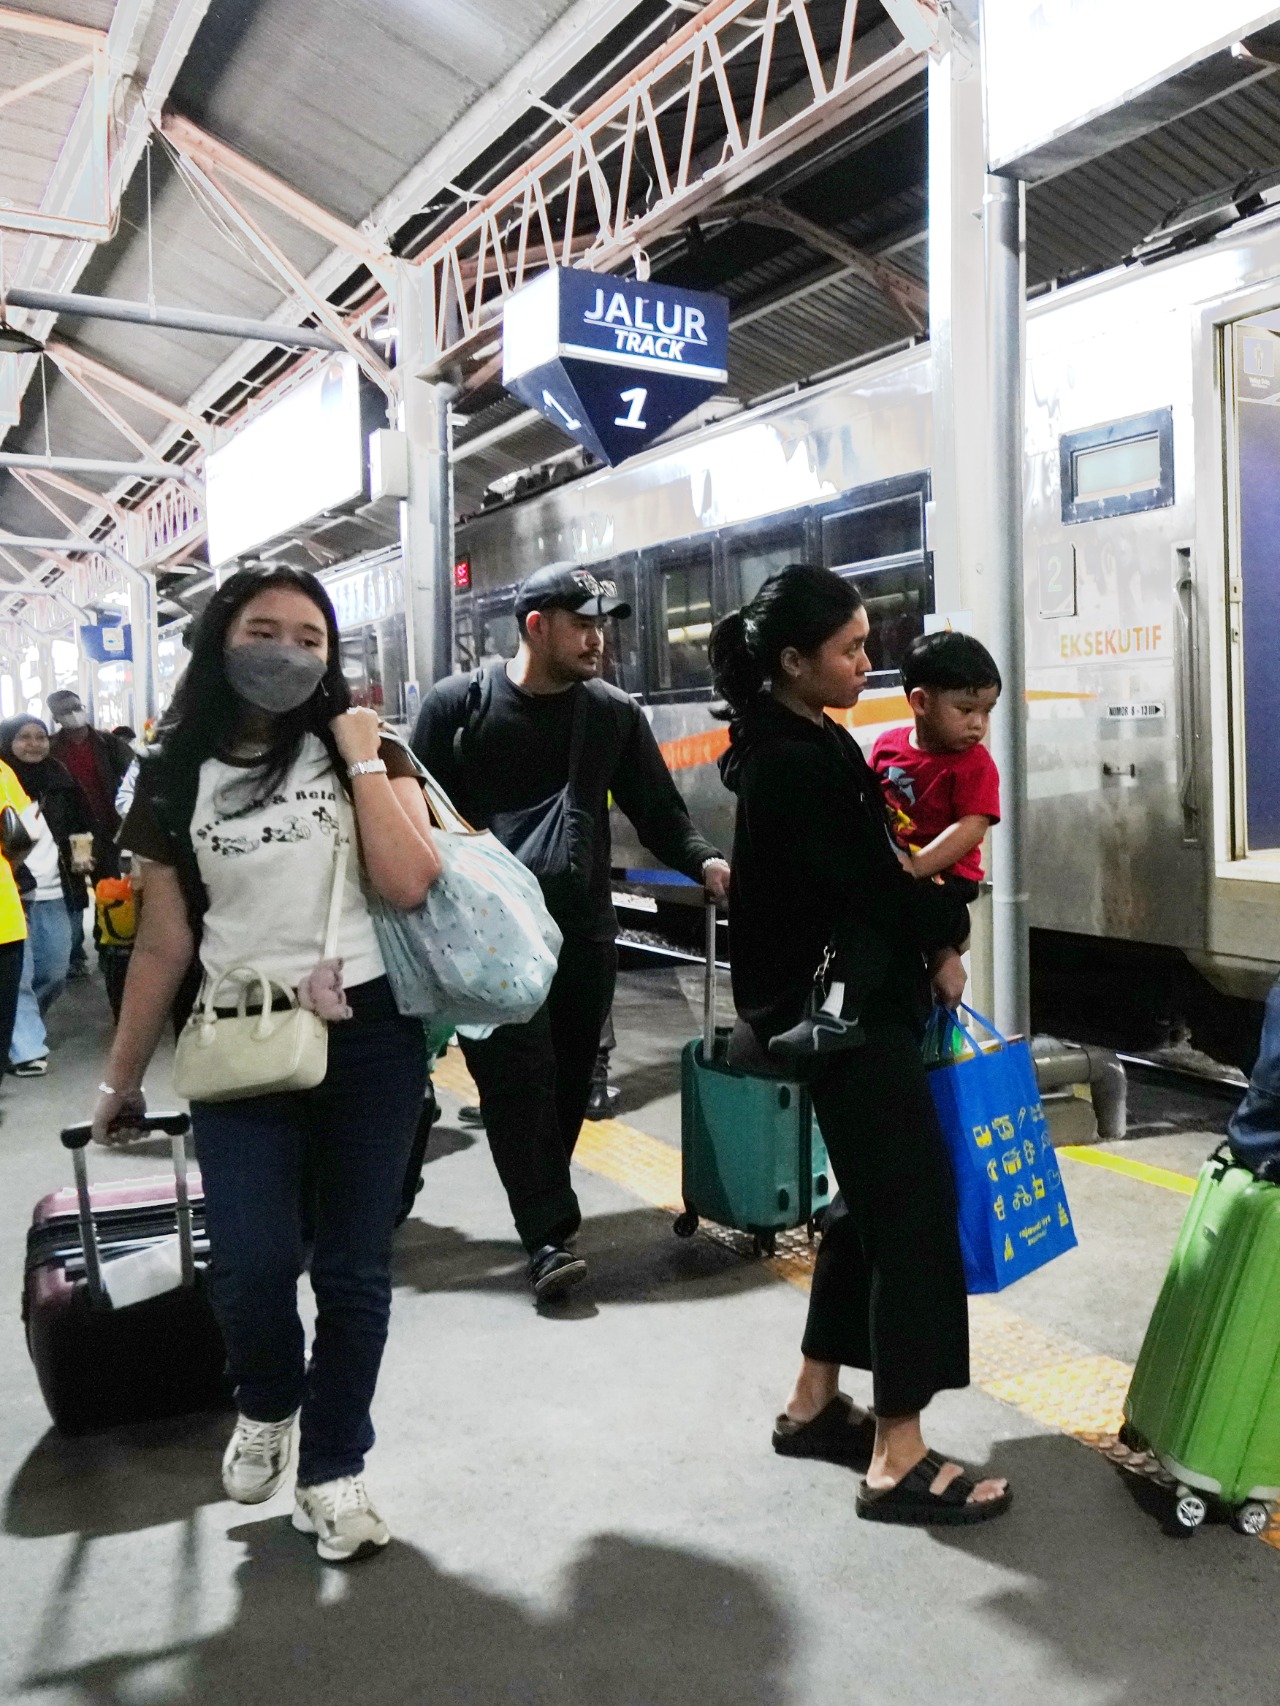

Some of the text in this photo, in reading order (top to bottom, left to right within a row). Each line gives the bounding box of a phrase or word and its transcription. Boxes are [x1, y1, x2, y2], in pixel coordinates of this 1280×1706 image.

[584, 289, 708, 342] JALUR
[615, 328, 685, 361] TRACK
[542, 388, 582, 431] 1
[614, 387, 648, 430] 1
[1047, 555, 1063, 593] 2
[1060, 625, 1162, 659] EKSEKUTIF
